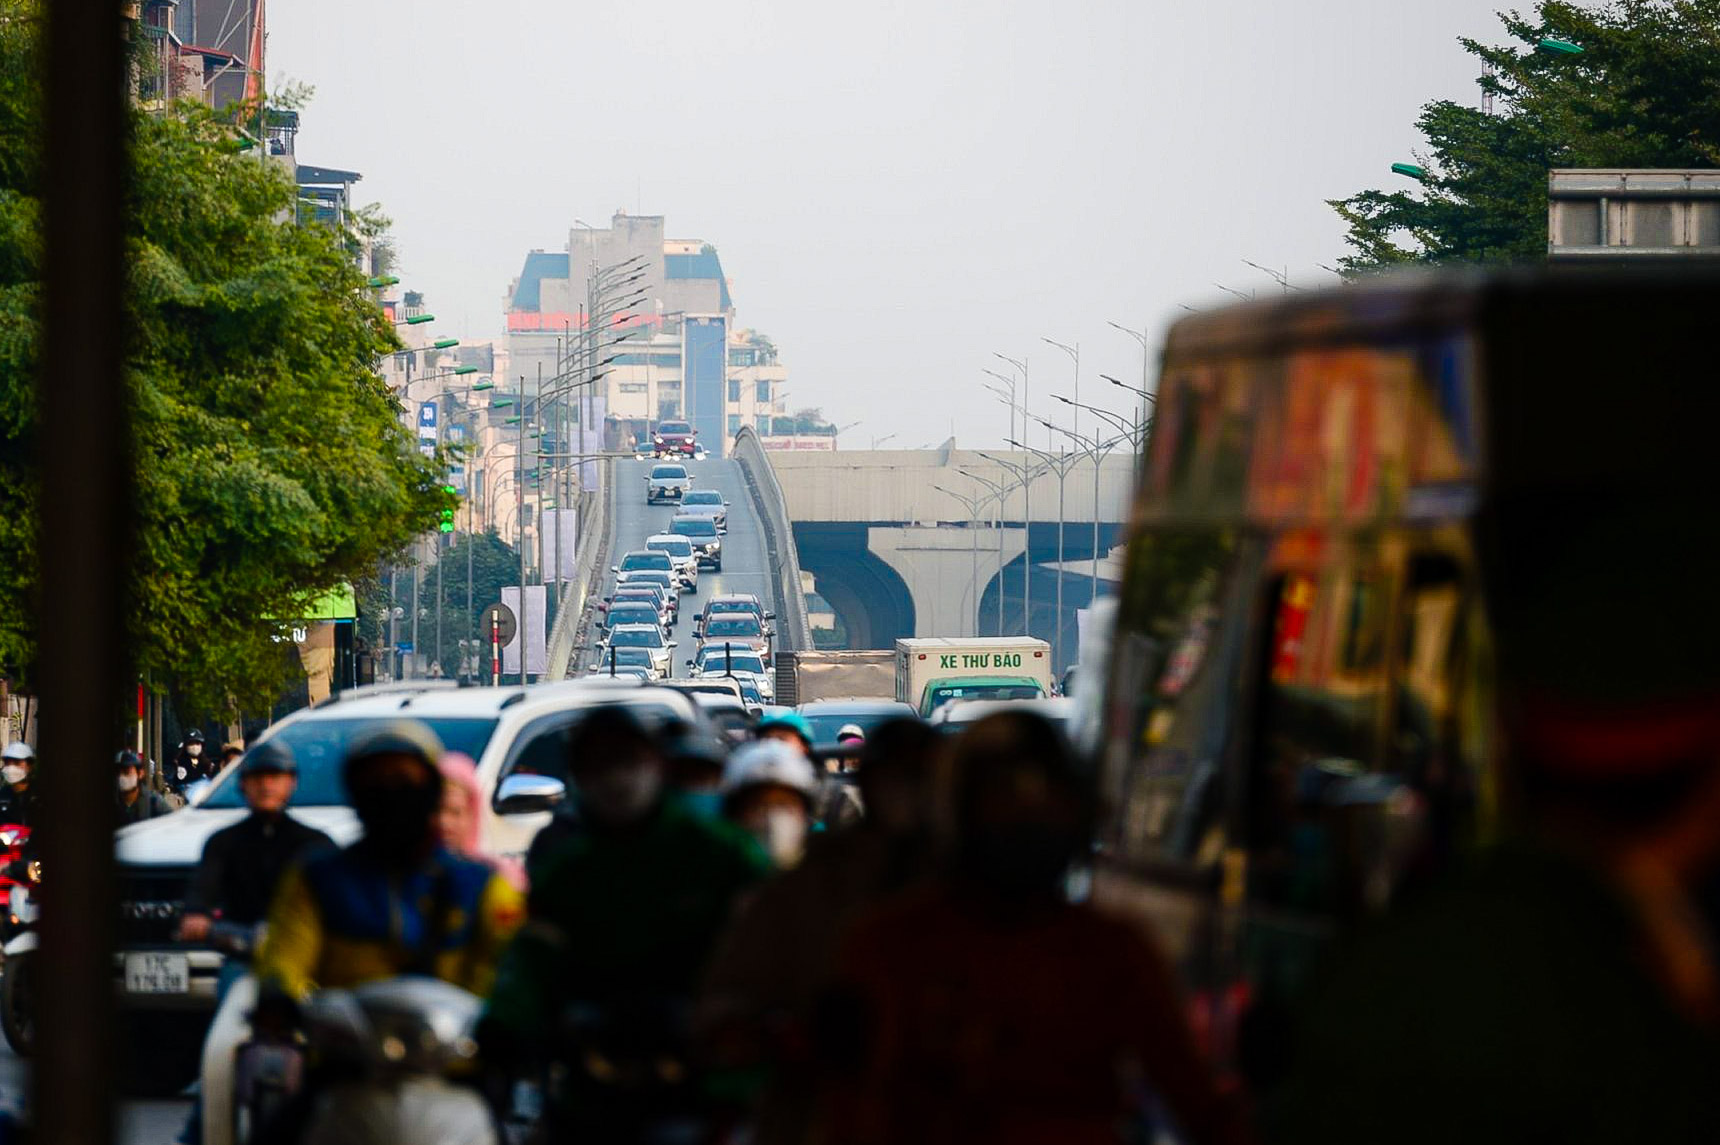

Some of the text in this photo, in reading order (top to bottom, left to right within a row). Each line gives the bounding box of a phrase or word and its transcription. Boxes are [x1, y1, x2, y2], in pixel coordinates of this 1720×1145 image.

[940, 652, 1021, 668] XE THƯ BÁO
